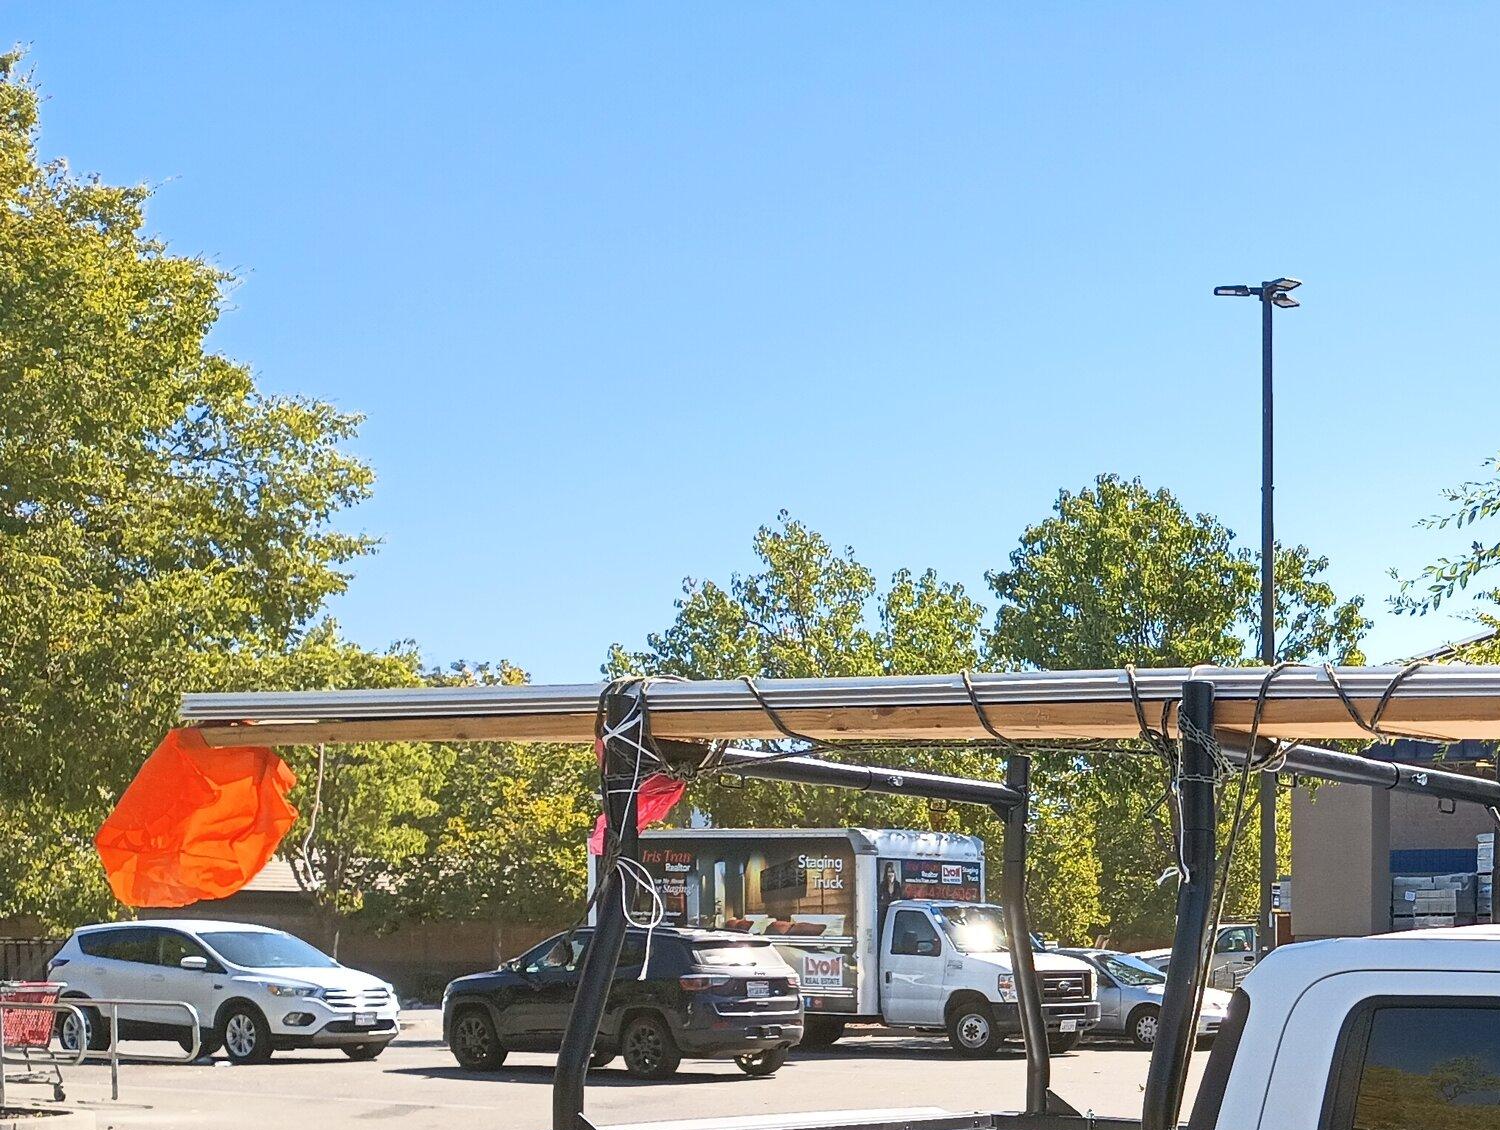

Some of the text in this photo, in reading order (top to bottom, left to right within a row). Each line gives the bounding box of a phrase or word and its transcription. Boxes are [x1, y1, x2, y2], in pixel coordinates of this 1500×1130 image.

[642, 849, 692, 863] Iris Tran
[798, 854, 843, 872] Staging
[812, 875, 844, 889] Truck
[805, 977, 840, 985] REAL ESTATE
